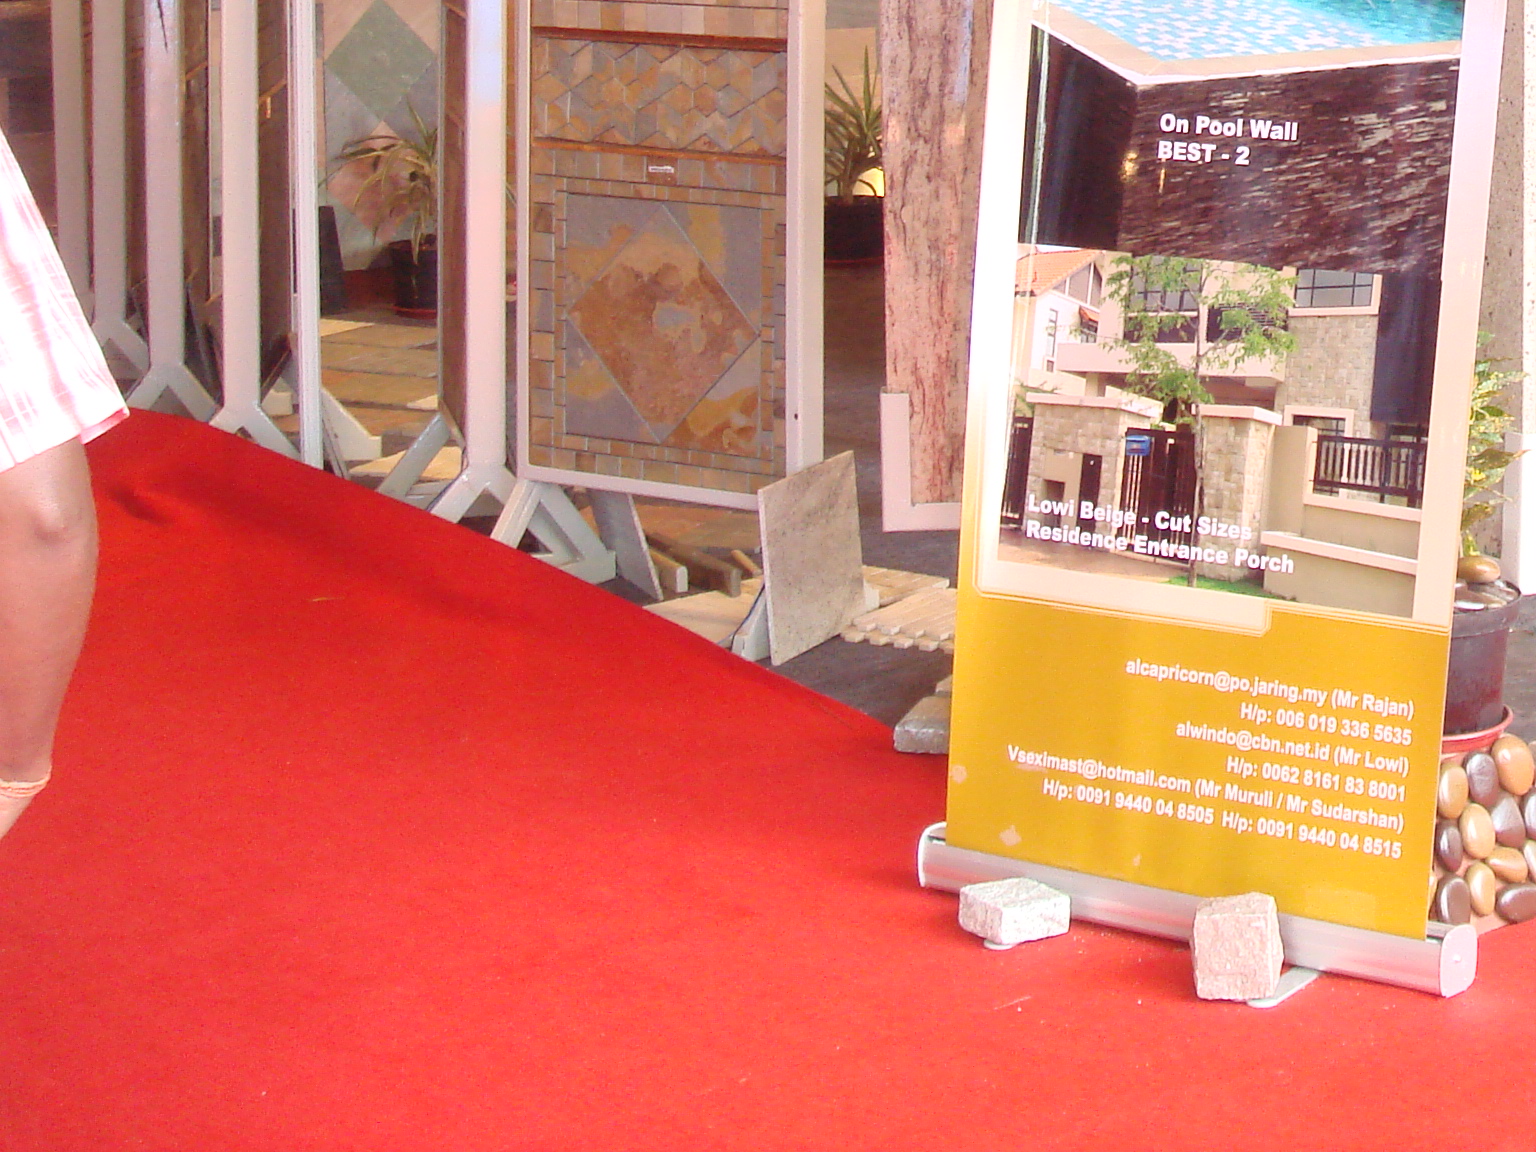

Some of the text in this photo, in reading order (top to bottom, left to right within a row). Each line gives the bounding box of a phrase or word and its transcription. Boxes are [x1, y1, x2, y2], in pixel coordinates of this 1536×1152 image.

[1159, 112, 1298, 141] On Pool Wall
[1157, 140, 1217, 164] BEST
[1234, 146, 1250, 166] 2
[1028, 493, 1075, 518] Lowi
[1079, 500, 1136, 528] Beige
[1154, 510, 1192, 534] Cut
[1196, 516, 1253, 541] Sizes
[1026, 519, 1294, 575] Residence Entrance Porch
[1125, 658, 1415, 721] alcapricorn@po.jaring.my (Mr Rajan)
[1176, 721, 1410, 778] alwindo@cbn.net.id (Mr Lowi)
[1240, 702, 1412, 746] H/p: 006 019 336 5635
[1007, 744, 1192, 793] Vseximast@hotmail.com
[1194, 778, 1221, 799] (Mr
[1224, 783, 1273, 808] Muruli
[1286, 794, 1308, 814] Mr
[1311, 798, 1404, 835] Sudarshan)
[1226, 756, 1406, 803] H/p: 0062 8161 83 8001
[1043, 778, 1402, 860] H/p: 0091 9440 04 8505 H/p: 0091 9440 04 8515
